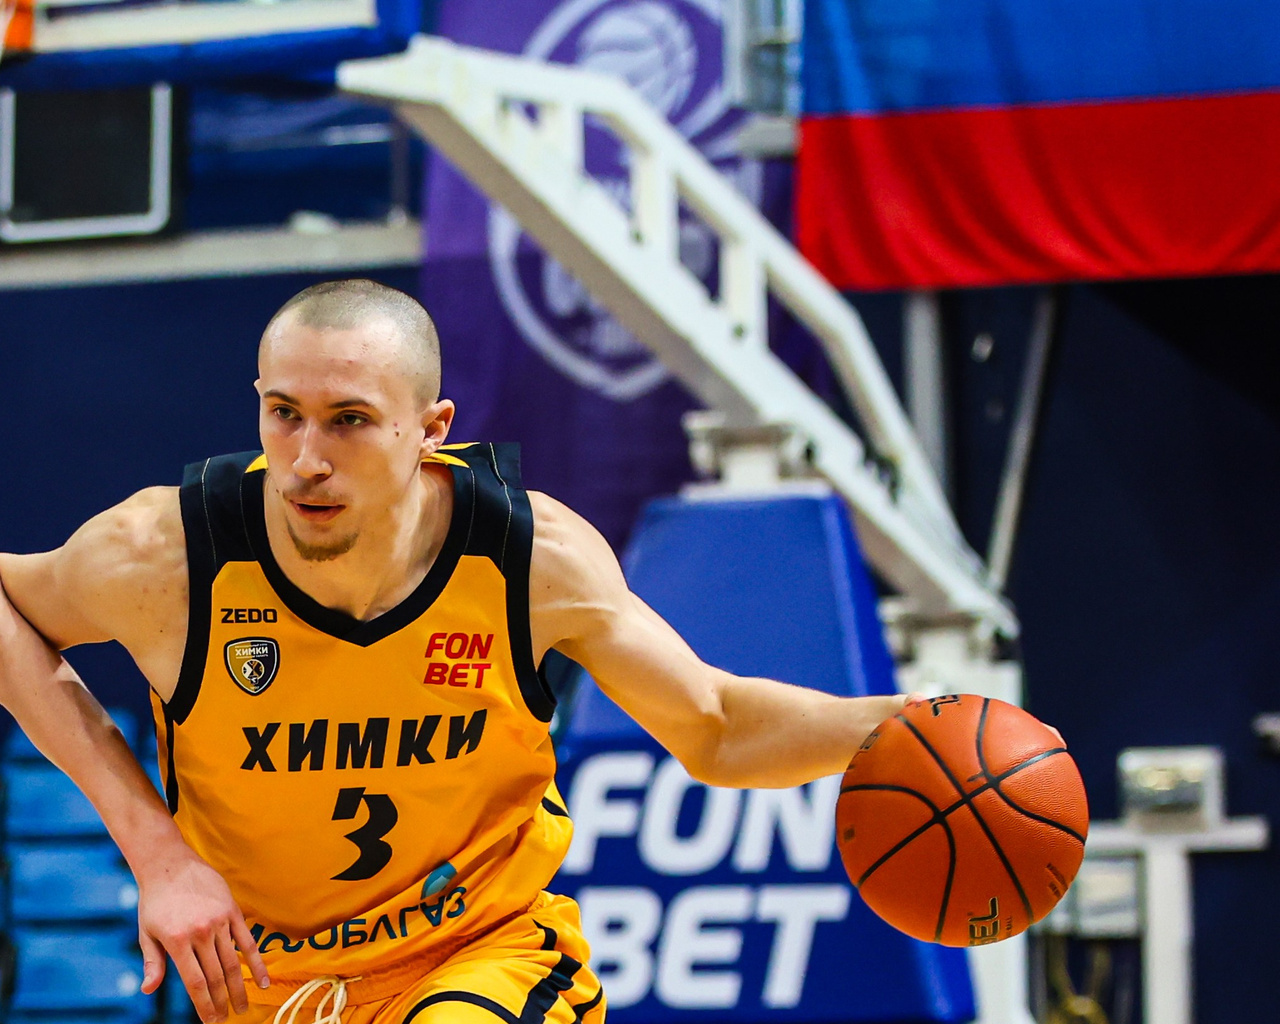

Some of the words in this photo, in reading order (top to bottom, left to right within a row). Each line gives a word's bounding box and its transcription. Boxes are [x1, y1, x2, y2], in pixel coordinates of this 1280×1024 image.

[220, 608, 278, 623] ZEDO
[235, 646, 269, 656] ХИМКИ
[425, 632, 494, 659] FON
[423, 663, 491, 688] BET
[240, 708, 487, 772] ХИМКИ
[329, 787, 398, 881] 3
[562, 751, 846, 876] FON
[576, 885, 851, 1009] BET
